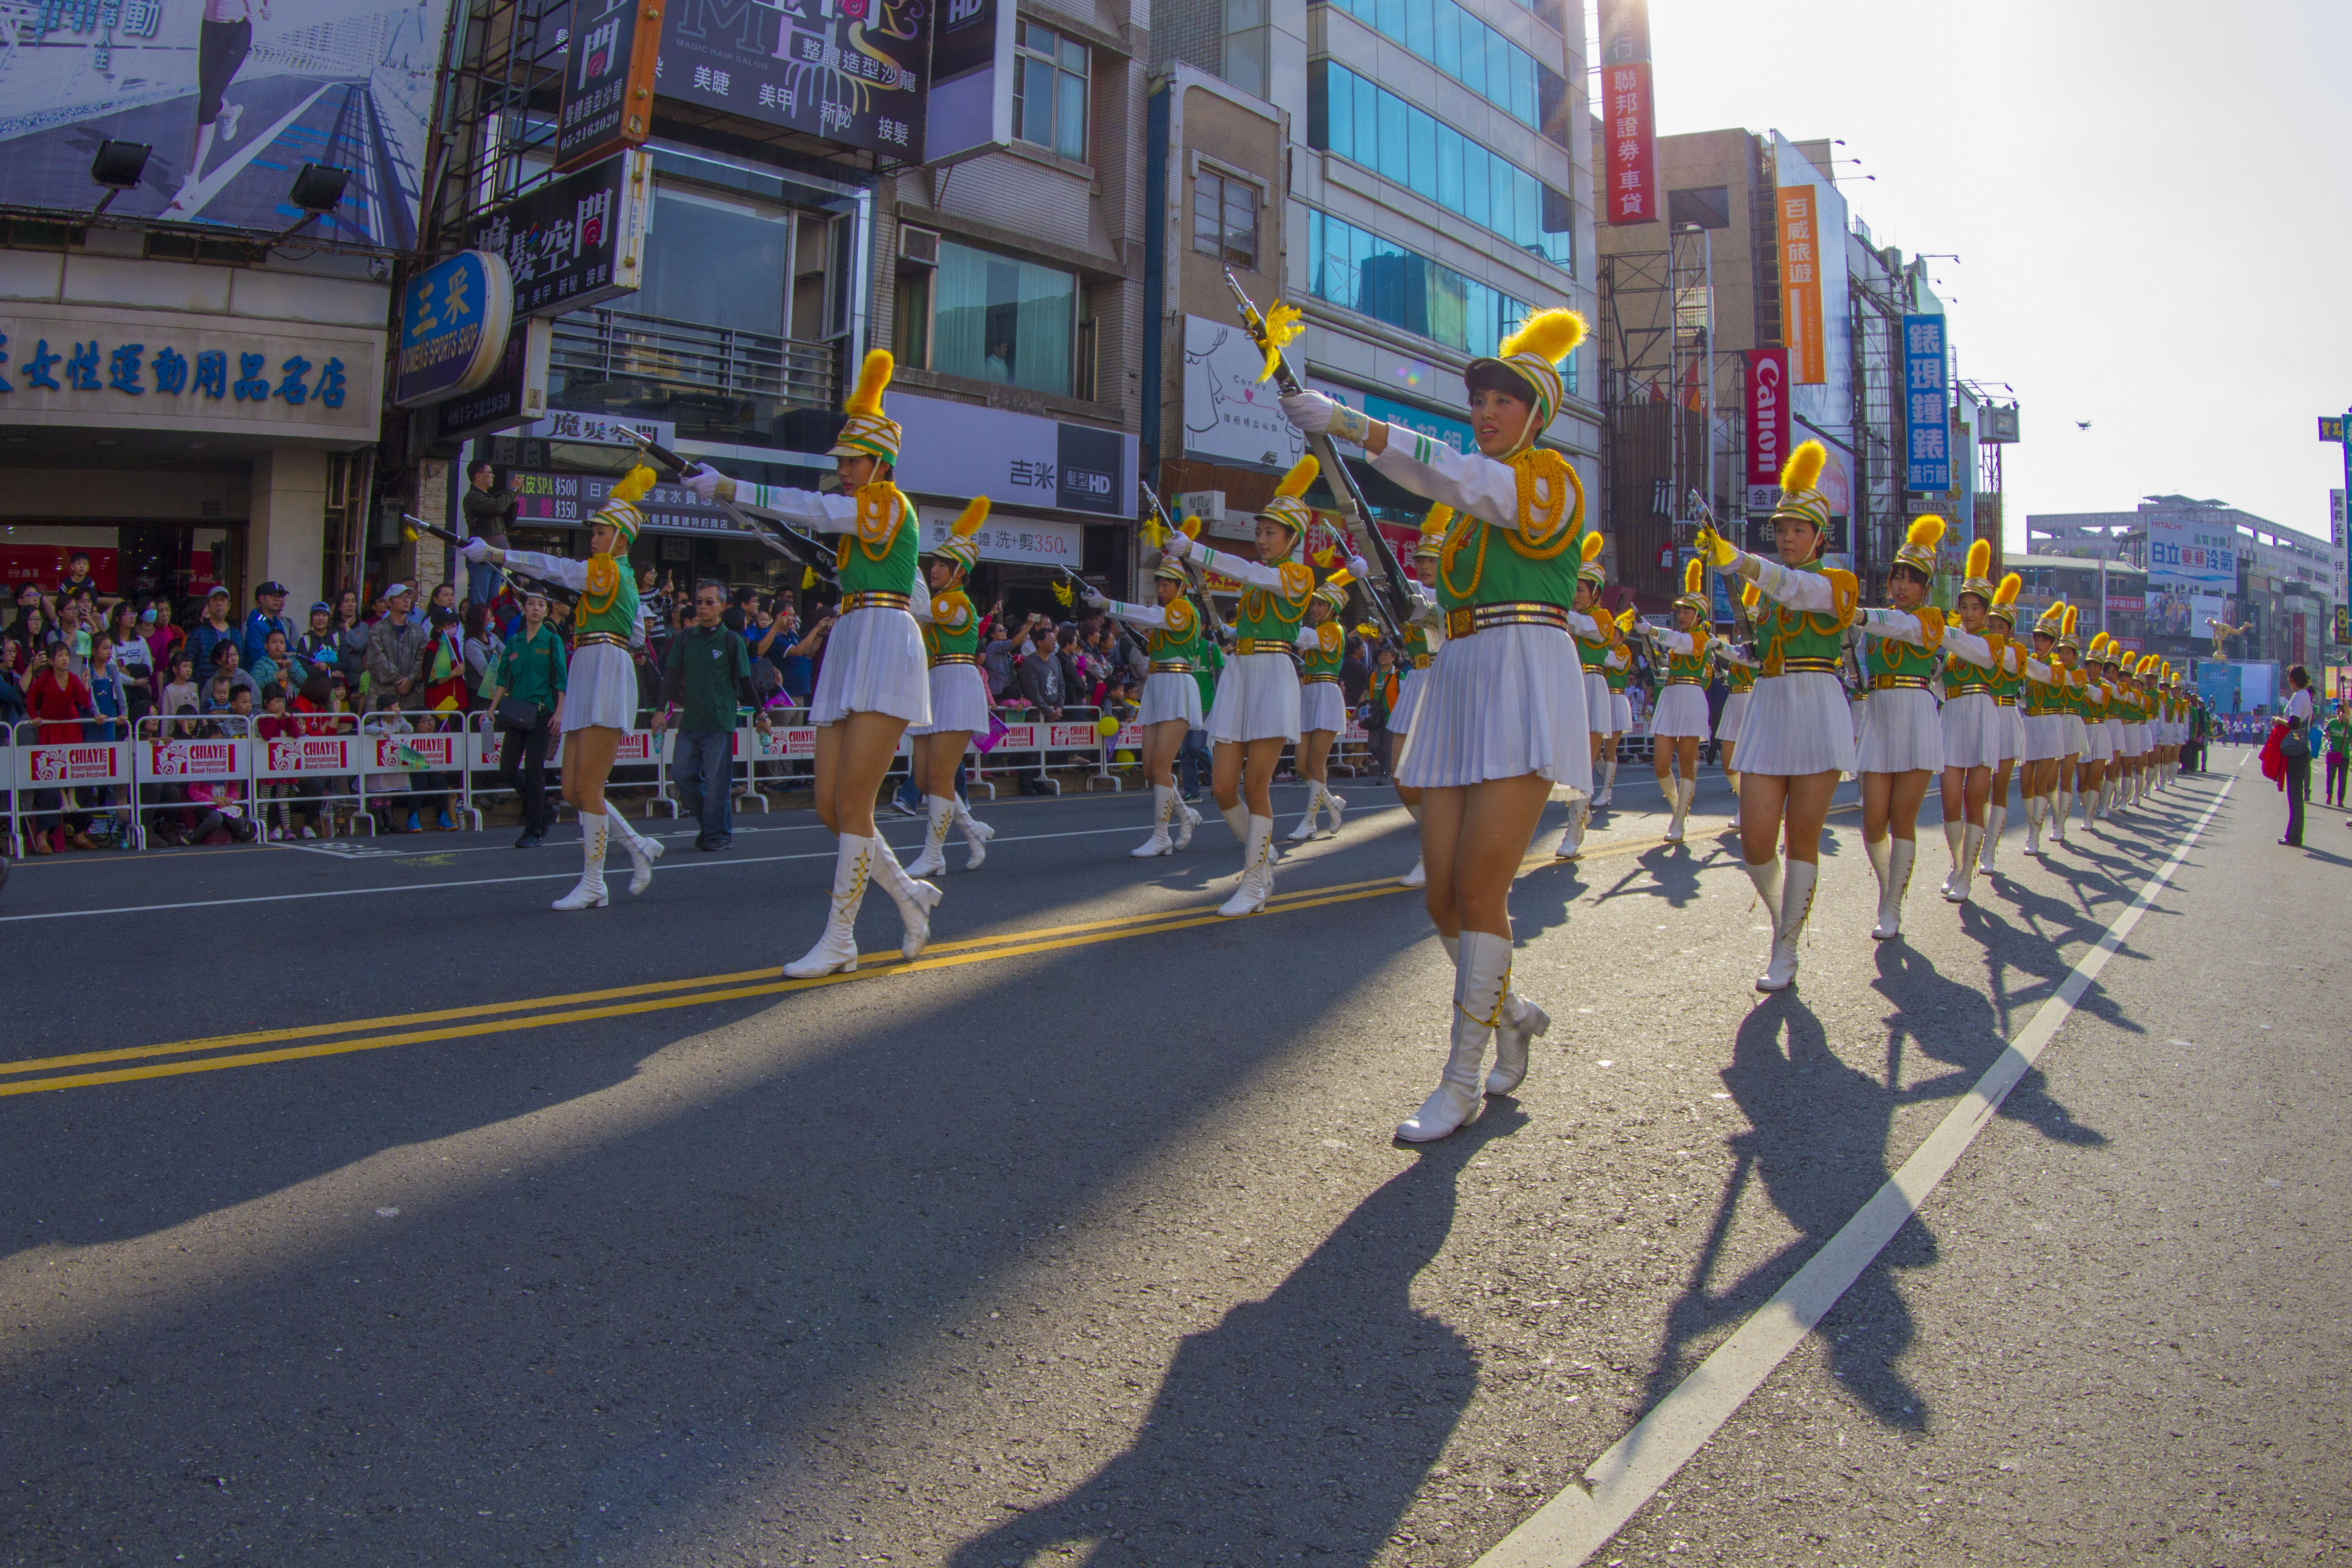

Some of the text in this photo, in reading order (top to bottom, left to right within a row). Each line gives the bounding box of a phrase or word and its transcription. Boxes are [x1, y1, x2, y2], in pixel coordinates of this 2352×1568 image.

[676, 39, 768, 70] MAGIC HAIR SALON
[802, 38, 916, 92] 整體造型沙龍
[693, 65, 730, 96] 美睫
[759, 83, 793, 111] 美甲
[820, 99, 852, 128] 新秘
[878, 116, 908, 147] 接髮
[561, 110, 619, 151] 05-2163020
[1784, 198, 1812, 283] 百威旅遊
[411, 266, 470, 337] 三采
[532, 284, 551, 306] 美甲
[429, 329, 458, 366] SPORTS
[458, 321, 478, 355] SHOP
[1909, 323, 1944, 459] 錶現鐘錶
[1223, 413, 1277, 433] 韓國精品服飾
[1757, 357, 1780, 472] Canon
[2321, 421, 2342, 437] 寶島
[1338, 438, 1351, 446] BANK
[1010, 459, 1055, 489] 吉米
[1067, 470, 1111, 494] 髮型 HD
[1910, 464, 1948, 484] 流行館
[555, 476, 577, 496] $500
[555, 499, 577, 518] $350
[1911, 502, 1947, 511] CITIZEN
[651, 514, 728, 529] 髮質重建特約商店
[2152, 520, 2183, 531] HITACHI
[2333, 496, 2344, 548] 嘉義名產
[2194, 533, 2209, 546] 品質
[620, 734, 637, 747] IAYI
[789, 731, 812, 742] CHIAYI
[1008, 727, 1027, 737] CHIAYI
[1070, 726, 1087, 735] CHIAYI
[69, 748, 103, 764] CHIAYI
[189, 745, 223, 760] CHIAYI
[303, 742, 335, 756] CHIAYI
